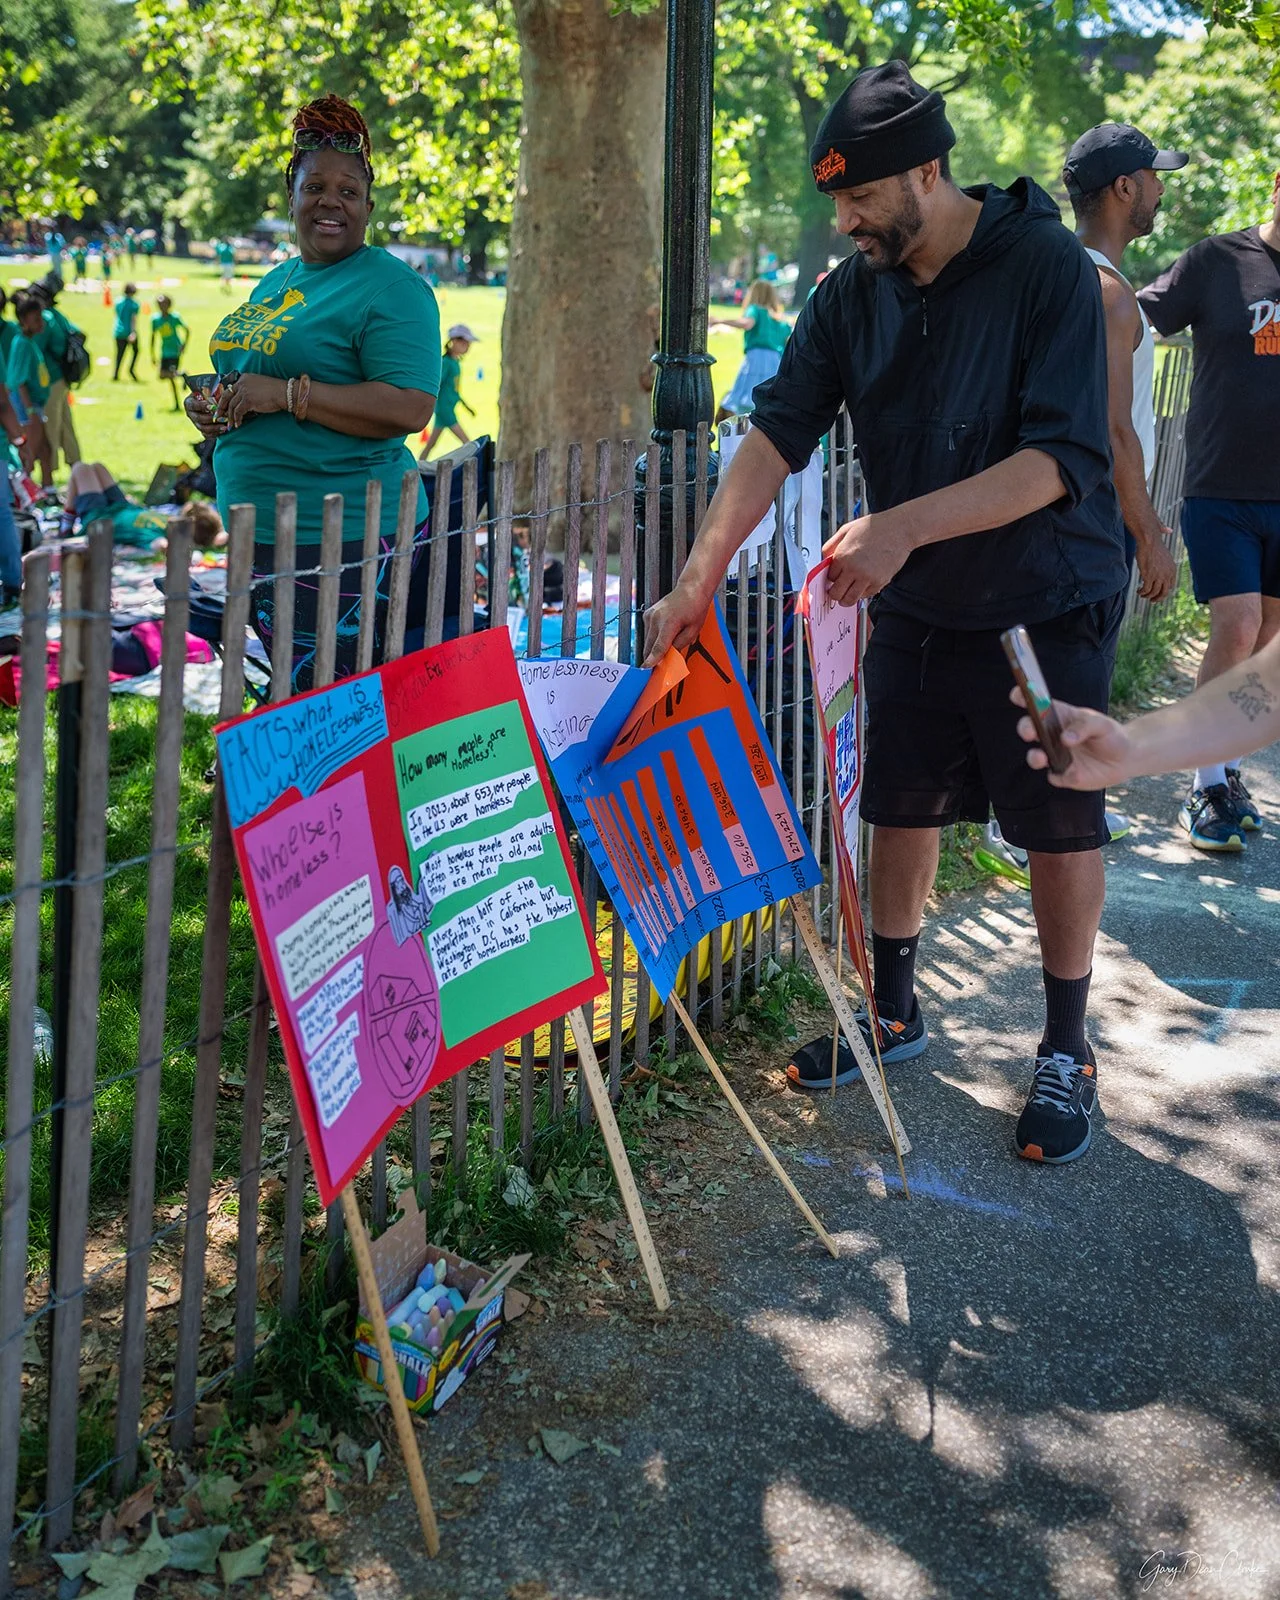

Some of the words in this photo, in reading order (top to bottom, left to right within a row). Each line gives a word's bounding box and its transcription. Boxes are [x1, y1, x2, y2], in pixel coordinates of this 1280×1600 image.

[251, 335, 277, 356] 20
[520, 660, 619, 686] Homelessness
[398, 753, 423, 789] How
[490, 728, 506, 741] are
[409, 810, 422, 831] In
[506, 772, 531, 793] people
[422, 825, 433, 839] the
[450, 812, 468, 828] were
[774, 812, 801, 854] 274,224
[425, 857, 441, 876] Most
[447, 847, 474, 864] homeless
[478, 837, 502, 855] people
[510, 831, 524, 844] are
[530, 821, 554, 838] adults
[733, 833, 754, 869] 256,610
[427, 871, 446, 888] often
[479, 853, 503, 869] years
[452, 878, 467, 889] are
[472, 867, 497, 883] men.
[754, 873, 774, 904] 2023
[433, 928, 453, 947] More
[458, 913, 476, 931] than
[517, 879, 535, 895] the
[472, 924, 481, 935] is
[486, 918, 495, 929] in
[500, 899, 537, 922] California
[539, 886, 555, 902] but
[711, 895, 727, 925] 2022
[438, 941, 476, 971] Washington
[502, 924, 519, 936] has
[526, 911, 543, 927] the
[546, 898, 573, 919] highest
[441, 967, 458, 982] rate
